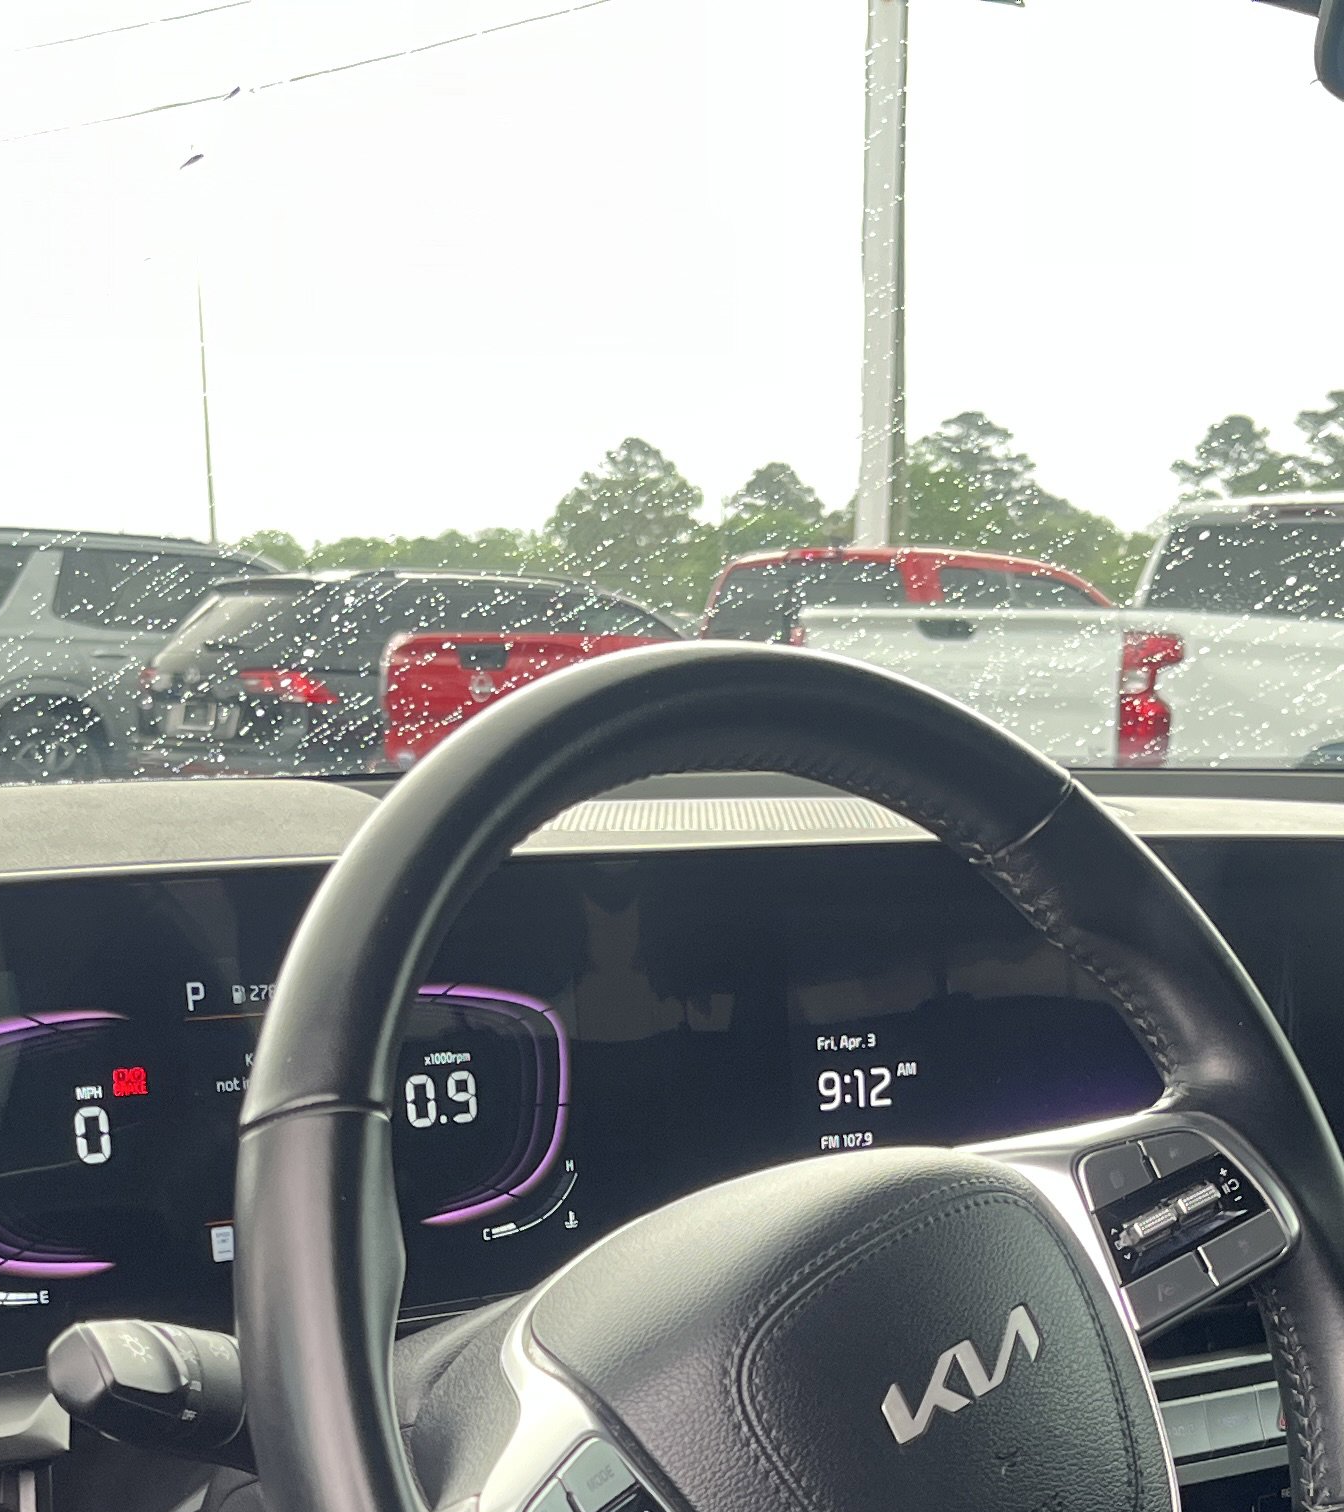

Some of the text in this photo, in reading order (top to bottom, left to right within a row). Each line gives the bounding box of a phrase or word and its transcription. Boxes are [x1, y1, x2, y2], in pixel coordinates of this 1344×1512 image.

[186, 981, 206, 1012] P
[840, 1034, 866, 1050] Apr.
[867, 1032, 877, 1048] 3
[424, 1052, 472, 1067] x1000rpm
[75, 1085, 104, 1100] MPH
[216, 1077, 241, 1093] not
[818, 1061, 917, 1111] 9:12 AM
[405, 1070, 479, 1129] 0.9
[74, 1106, 112, 1165] 0
[820, 1132, 873, 1150] FM 107.9
[565, 1160, 575, 1172] H
[482, 1228, 492, 1241] C
[39, 1290, 50, 1304] E
[881, 1304, 1040, 1444] KIA
